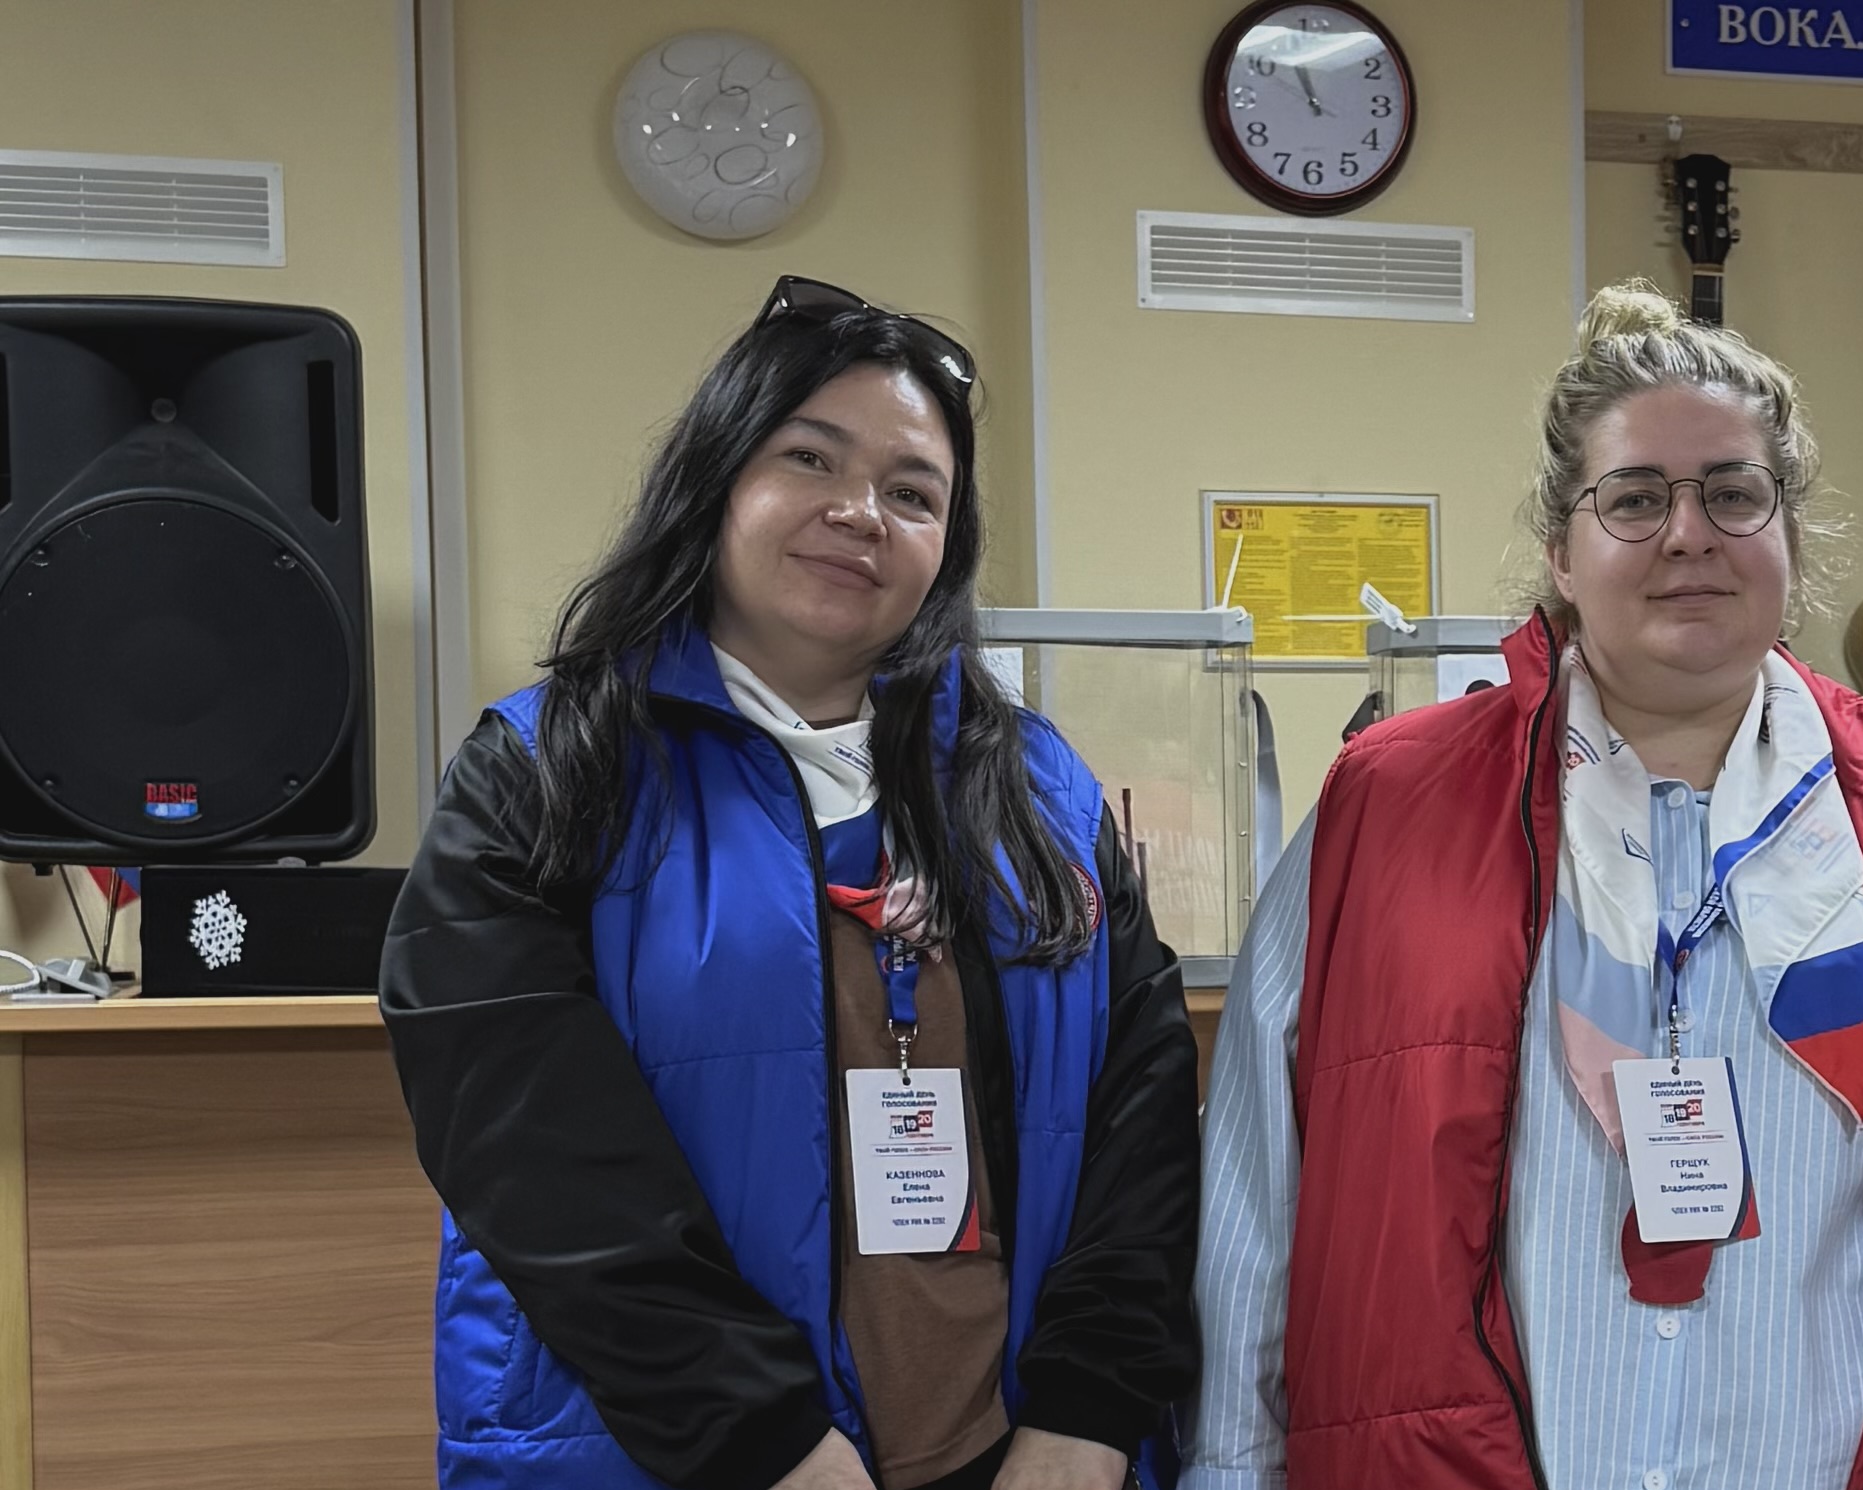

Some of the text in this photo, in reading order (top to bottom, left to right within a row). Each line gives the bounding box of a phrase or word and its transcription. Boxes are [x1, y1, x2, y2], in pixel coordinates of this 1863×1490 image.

[1363, 57, 1382, 80] 2
[1371, 95, 1392, 118] 3
[1246, 121, 1269, 147] 8
[1361, 128, 1380, 150] 4
[1273, 152, 1292, 176] 7
[1302, 160, 1324, 185] 6
[1339, 152, 1359, 177] 5
[882, 1100, 937, 1108] ГОЛОСОВАНИЯ
[1651, 1089, 1705, 1097] ГОЛОСОВАНИЯ
[1664, 1102, 1701, 1123] 18 19 20
[892, 1114, 931, 1134] 18 19 20
[903, 1183, 930, 1191] Елена
[1660, 1183, 1728, 1193] Владимировна
